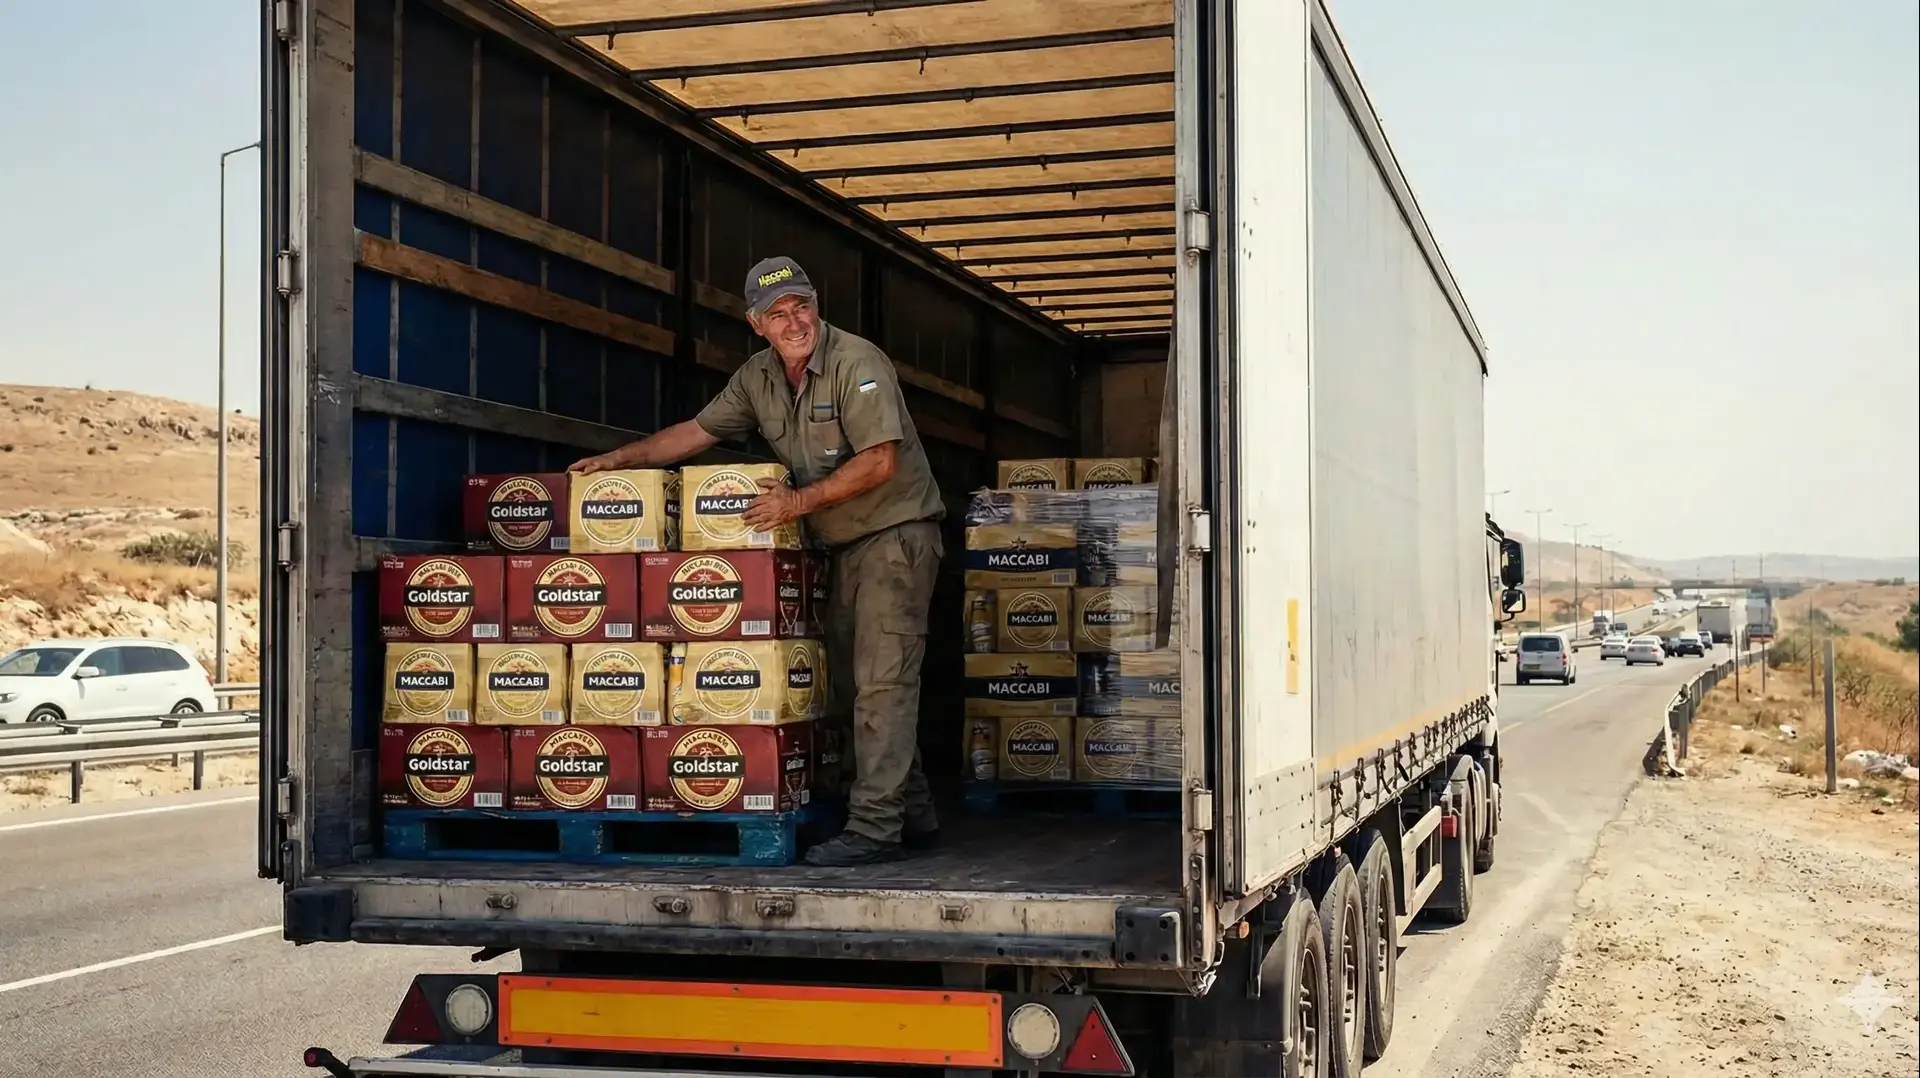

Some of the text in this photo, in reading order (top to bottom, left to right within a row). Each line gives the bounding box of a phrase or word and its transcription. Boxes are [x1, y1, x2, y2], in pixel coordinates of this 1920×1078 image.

[491, 505, 547, 518] Goldstar
[586, 503, 638, 514] MACCABI
[988, 554, 1049, 566] MACCABI
[408, 590, 469, 603] Goldstar
[538, 589, 601, 602] Goldstar
[672, 586, 737, 600] Goldstar
[1011, 615, 1052, 623] MACCABI
[401, 676, 448, 686] MACCABI
[494, 676, 543, 687] MACCABI
[588, 676, 639, 687] MACCABI
[702, 675, 754, 685] MACCABI
[988, 682, 1049, 694] MACCABI
[1012, 743, 1054, 751] MACCABI
[408, 758, 470, 771] Goldstar
[539, 758, 604, 772] Goldstar
[673, 760, 739, 774] Goldstar
